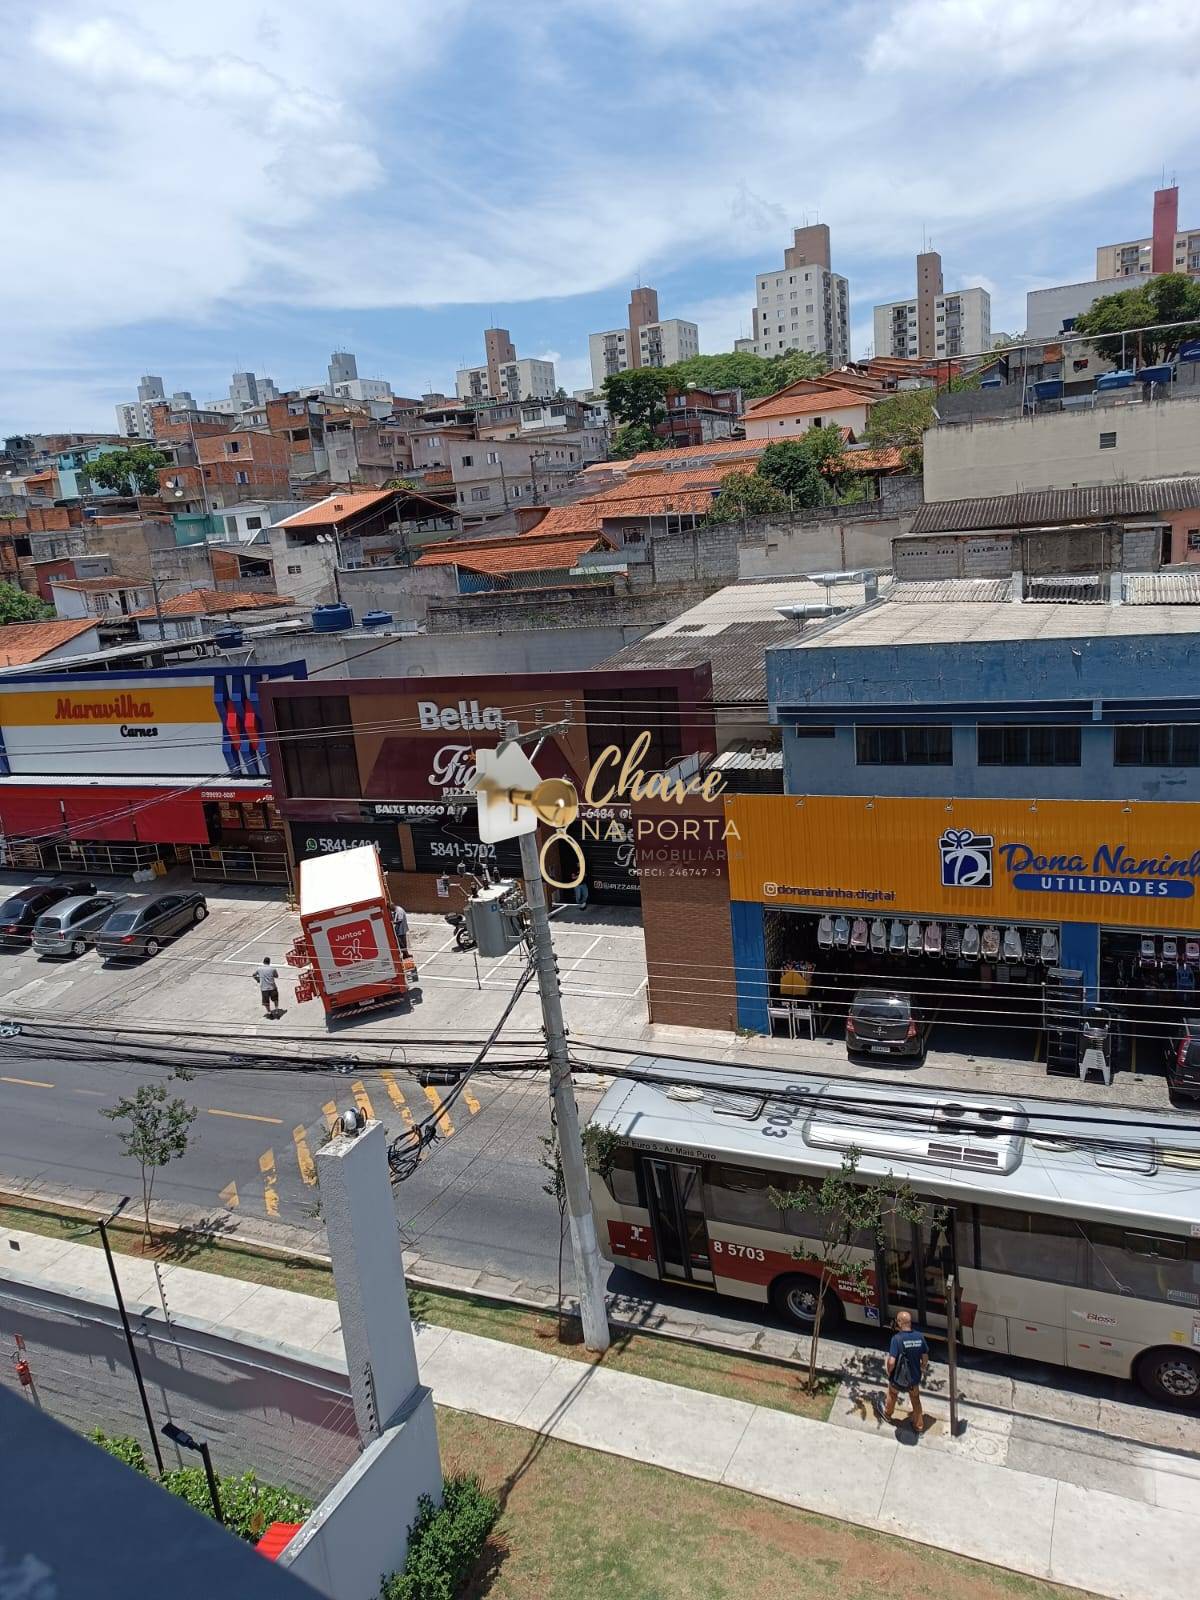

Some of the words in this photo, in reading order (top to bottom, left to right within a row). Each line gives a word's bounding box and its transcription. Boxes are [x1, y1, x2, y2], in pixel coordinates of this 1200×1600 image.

[55, 694, 154, 720] Maravilha
[417, 700, 502, 731] Bella
[120, 725, 158, 738] Carnes
[375, 804, 406, 815] BAIXE
[407, 805, 445, 816] NOSSO
[430, 841, 497, 860] 5841-5702
[998, 842, 1089, 873] Dona
[778, 885, 897, 902] donananinha.digital
[1041, 877, 1169, 896] UTILIDADES
[696, 1150, 718, 1160] Puro
[713, 1241, 723, 1253] 8
[728, 1243, 766, 1262] 5703
